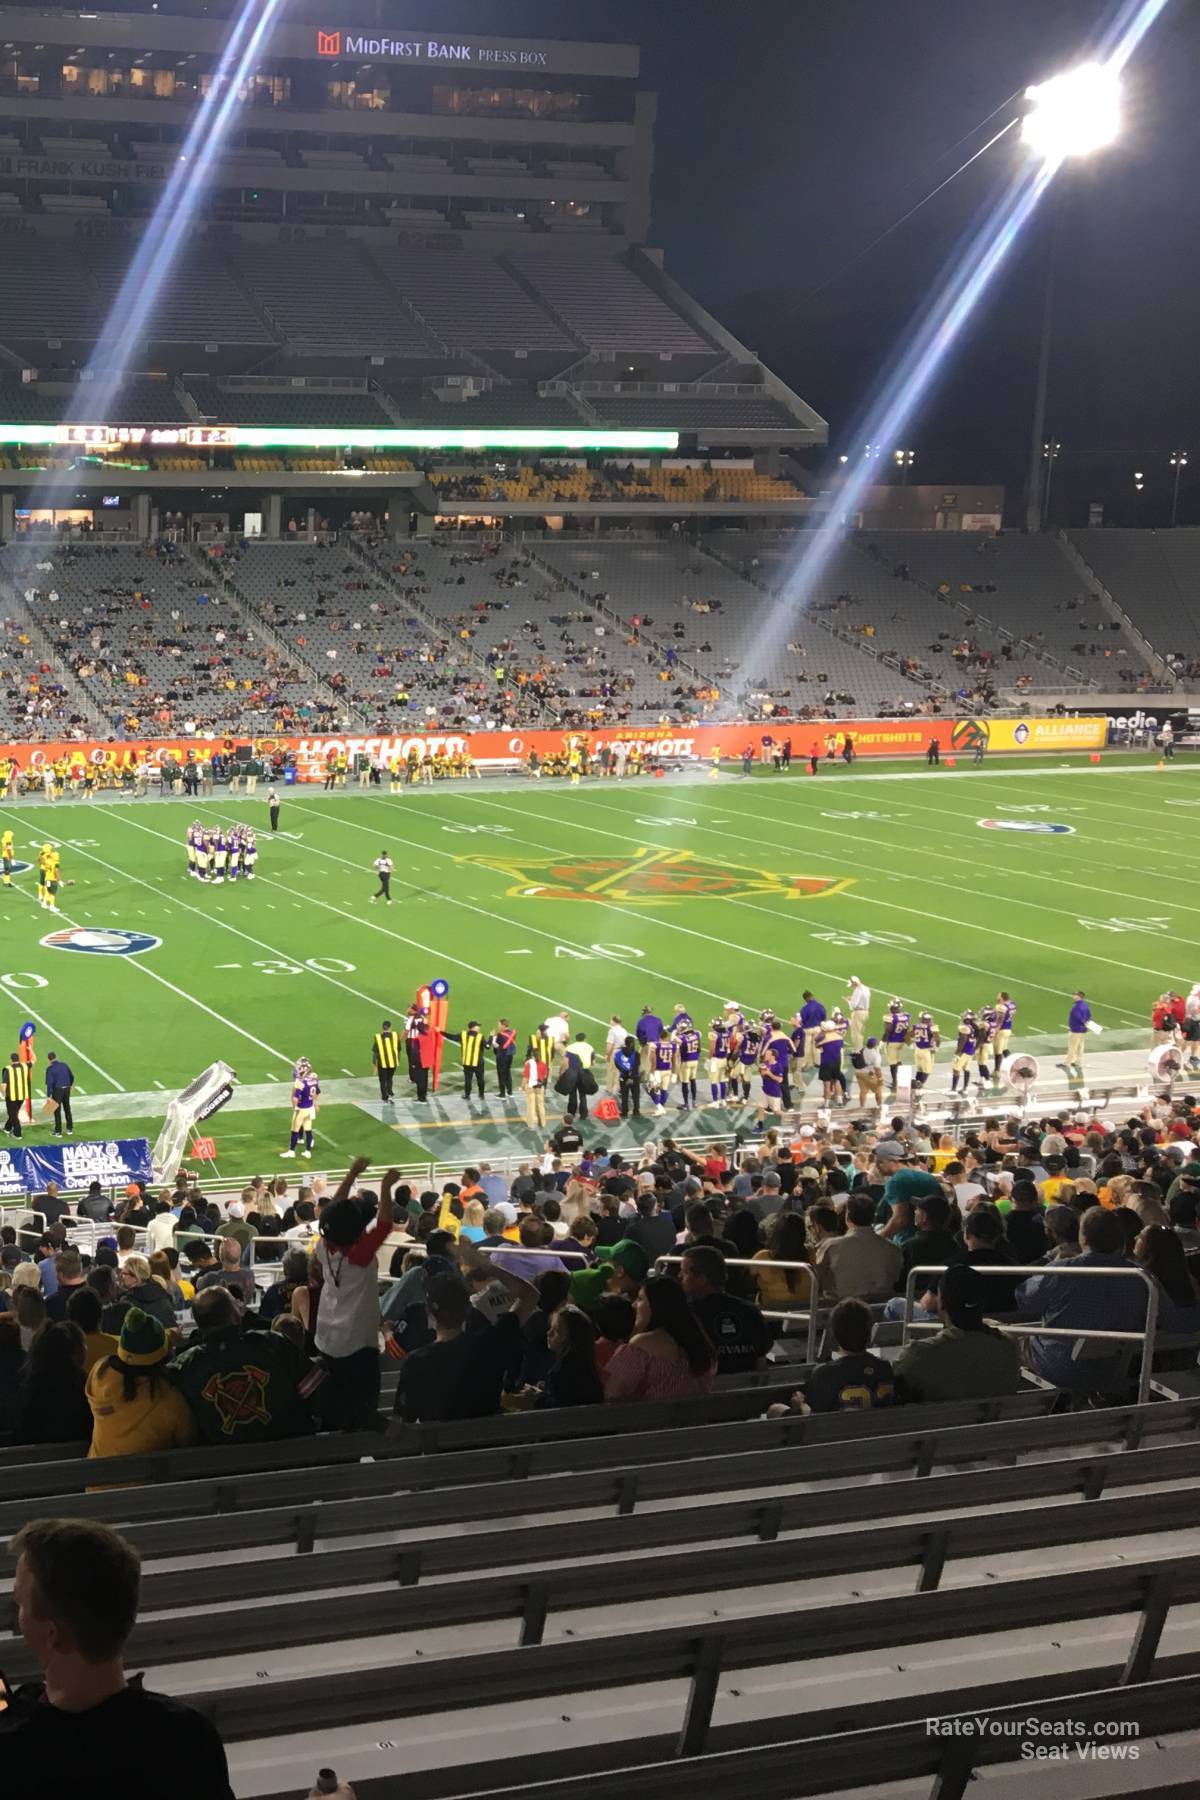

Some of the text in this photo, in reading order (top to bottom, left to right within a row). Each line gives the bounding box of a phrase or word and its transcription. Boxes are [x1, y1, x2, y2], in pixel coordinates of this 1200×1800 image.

[478, 49, 517, 63] PRESS
[519, 51, 548, 65] BOX
[17, 159, 74, 176] FRANK
[81, 163, 128, 178] KUSH
[135, 164, 174, 179] FIEL
[1034, 723, 1100, 736] ALLIANCE
[809, 930, 918, 946] 50
[554, 943, 647, 961] 40
[251, 957, 358, 976] 30
[601, 1099, 617, 1117] 30
[62, 1143, 104, 1161] NAVY
[64, 1156, 130, 1173] FEDERAL
